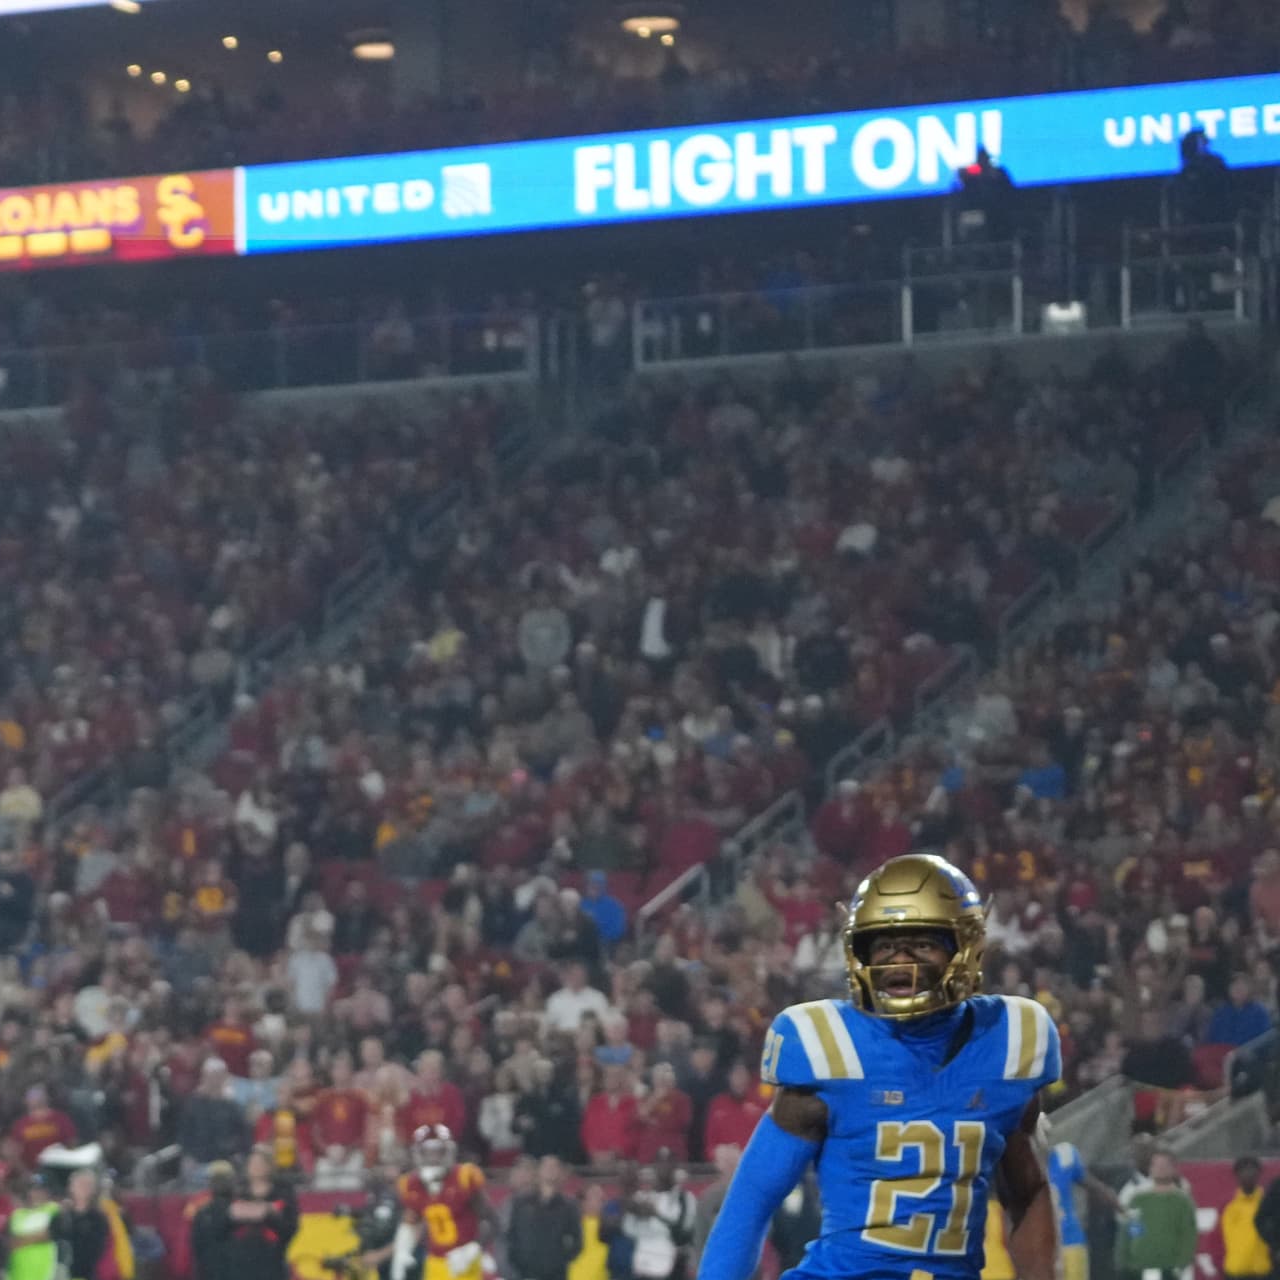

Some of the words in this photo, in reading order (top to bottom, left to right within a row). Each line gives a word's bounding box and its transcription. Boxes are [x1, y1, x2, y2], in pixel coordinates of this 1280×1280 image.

[258, 179, 435, 223] UNITED
[573, 125, 837, 214] FLIGHT
[851, 109, 1002, 189] ON!
[861, 1119, 986, 1257] 21
